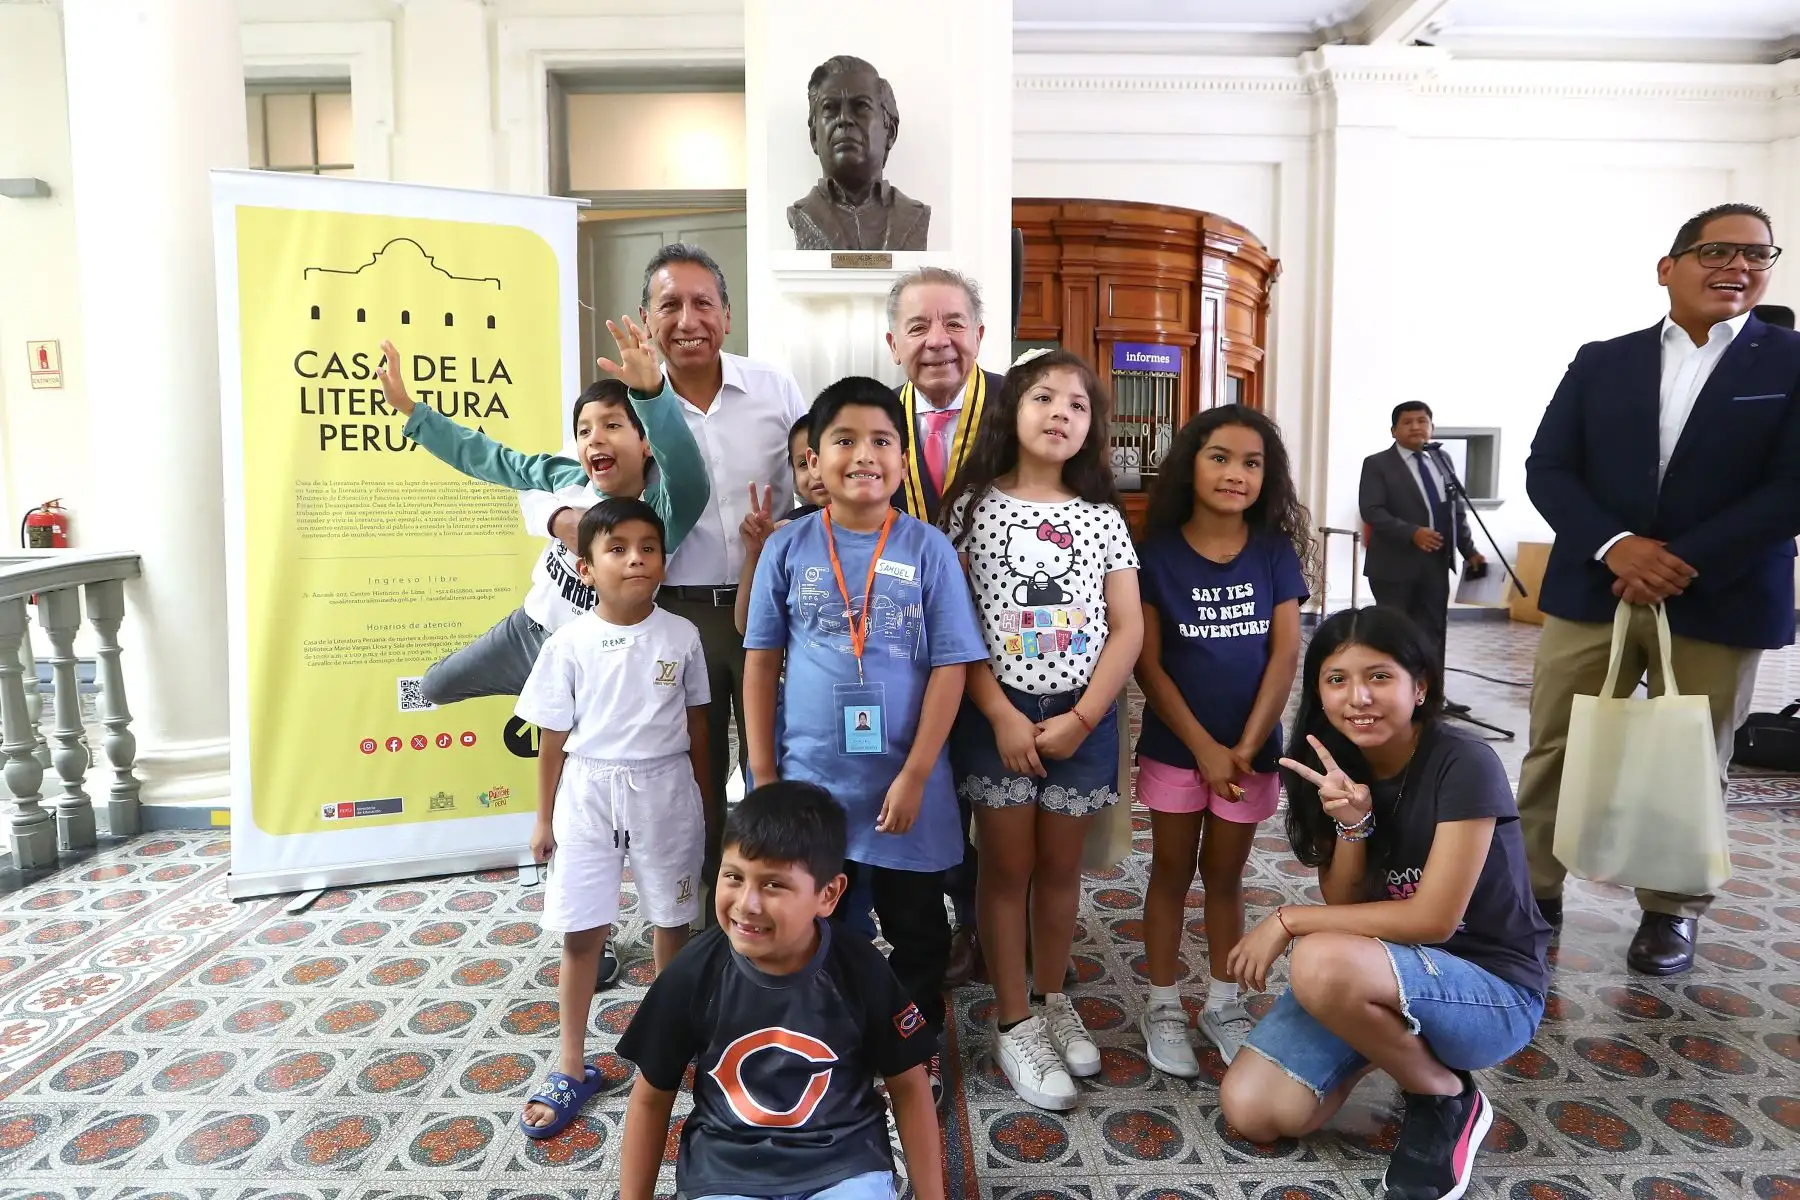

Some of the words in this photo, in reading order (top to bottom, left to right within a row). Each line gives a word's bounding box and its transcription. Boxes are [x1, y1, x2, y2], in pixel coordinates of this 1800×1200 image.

[1126, 352, 1170, 364] informes
[413, 354, 457, 382] DE
[472, 357, 513, 384] LA
[300, 386, 509, 418] LITERTURA
[320, 424, 486, 452] PERU
[880, 562, 909, 578] SAMUEL
[368, 576, 420, 586] Ingreso
[1192, 588, 1222, 602] SAY
[1226, 582, 1254, 600] YES
[1198, 606, 1217, 620] TO
[1220, 602, 1256, 620] NEW
[602, 637, 626, 648] RENE
[708, 1026, 839, 1128] C
